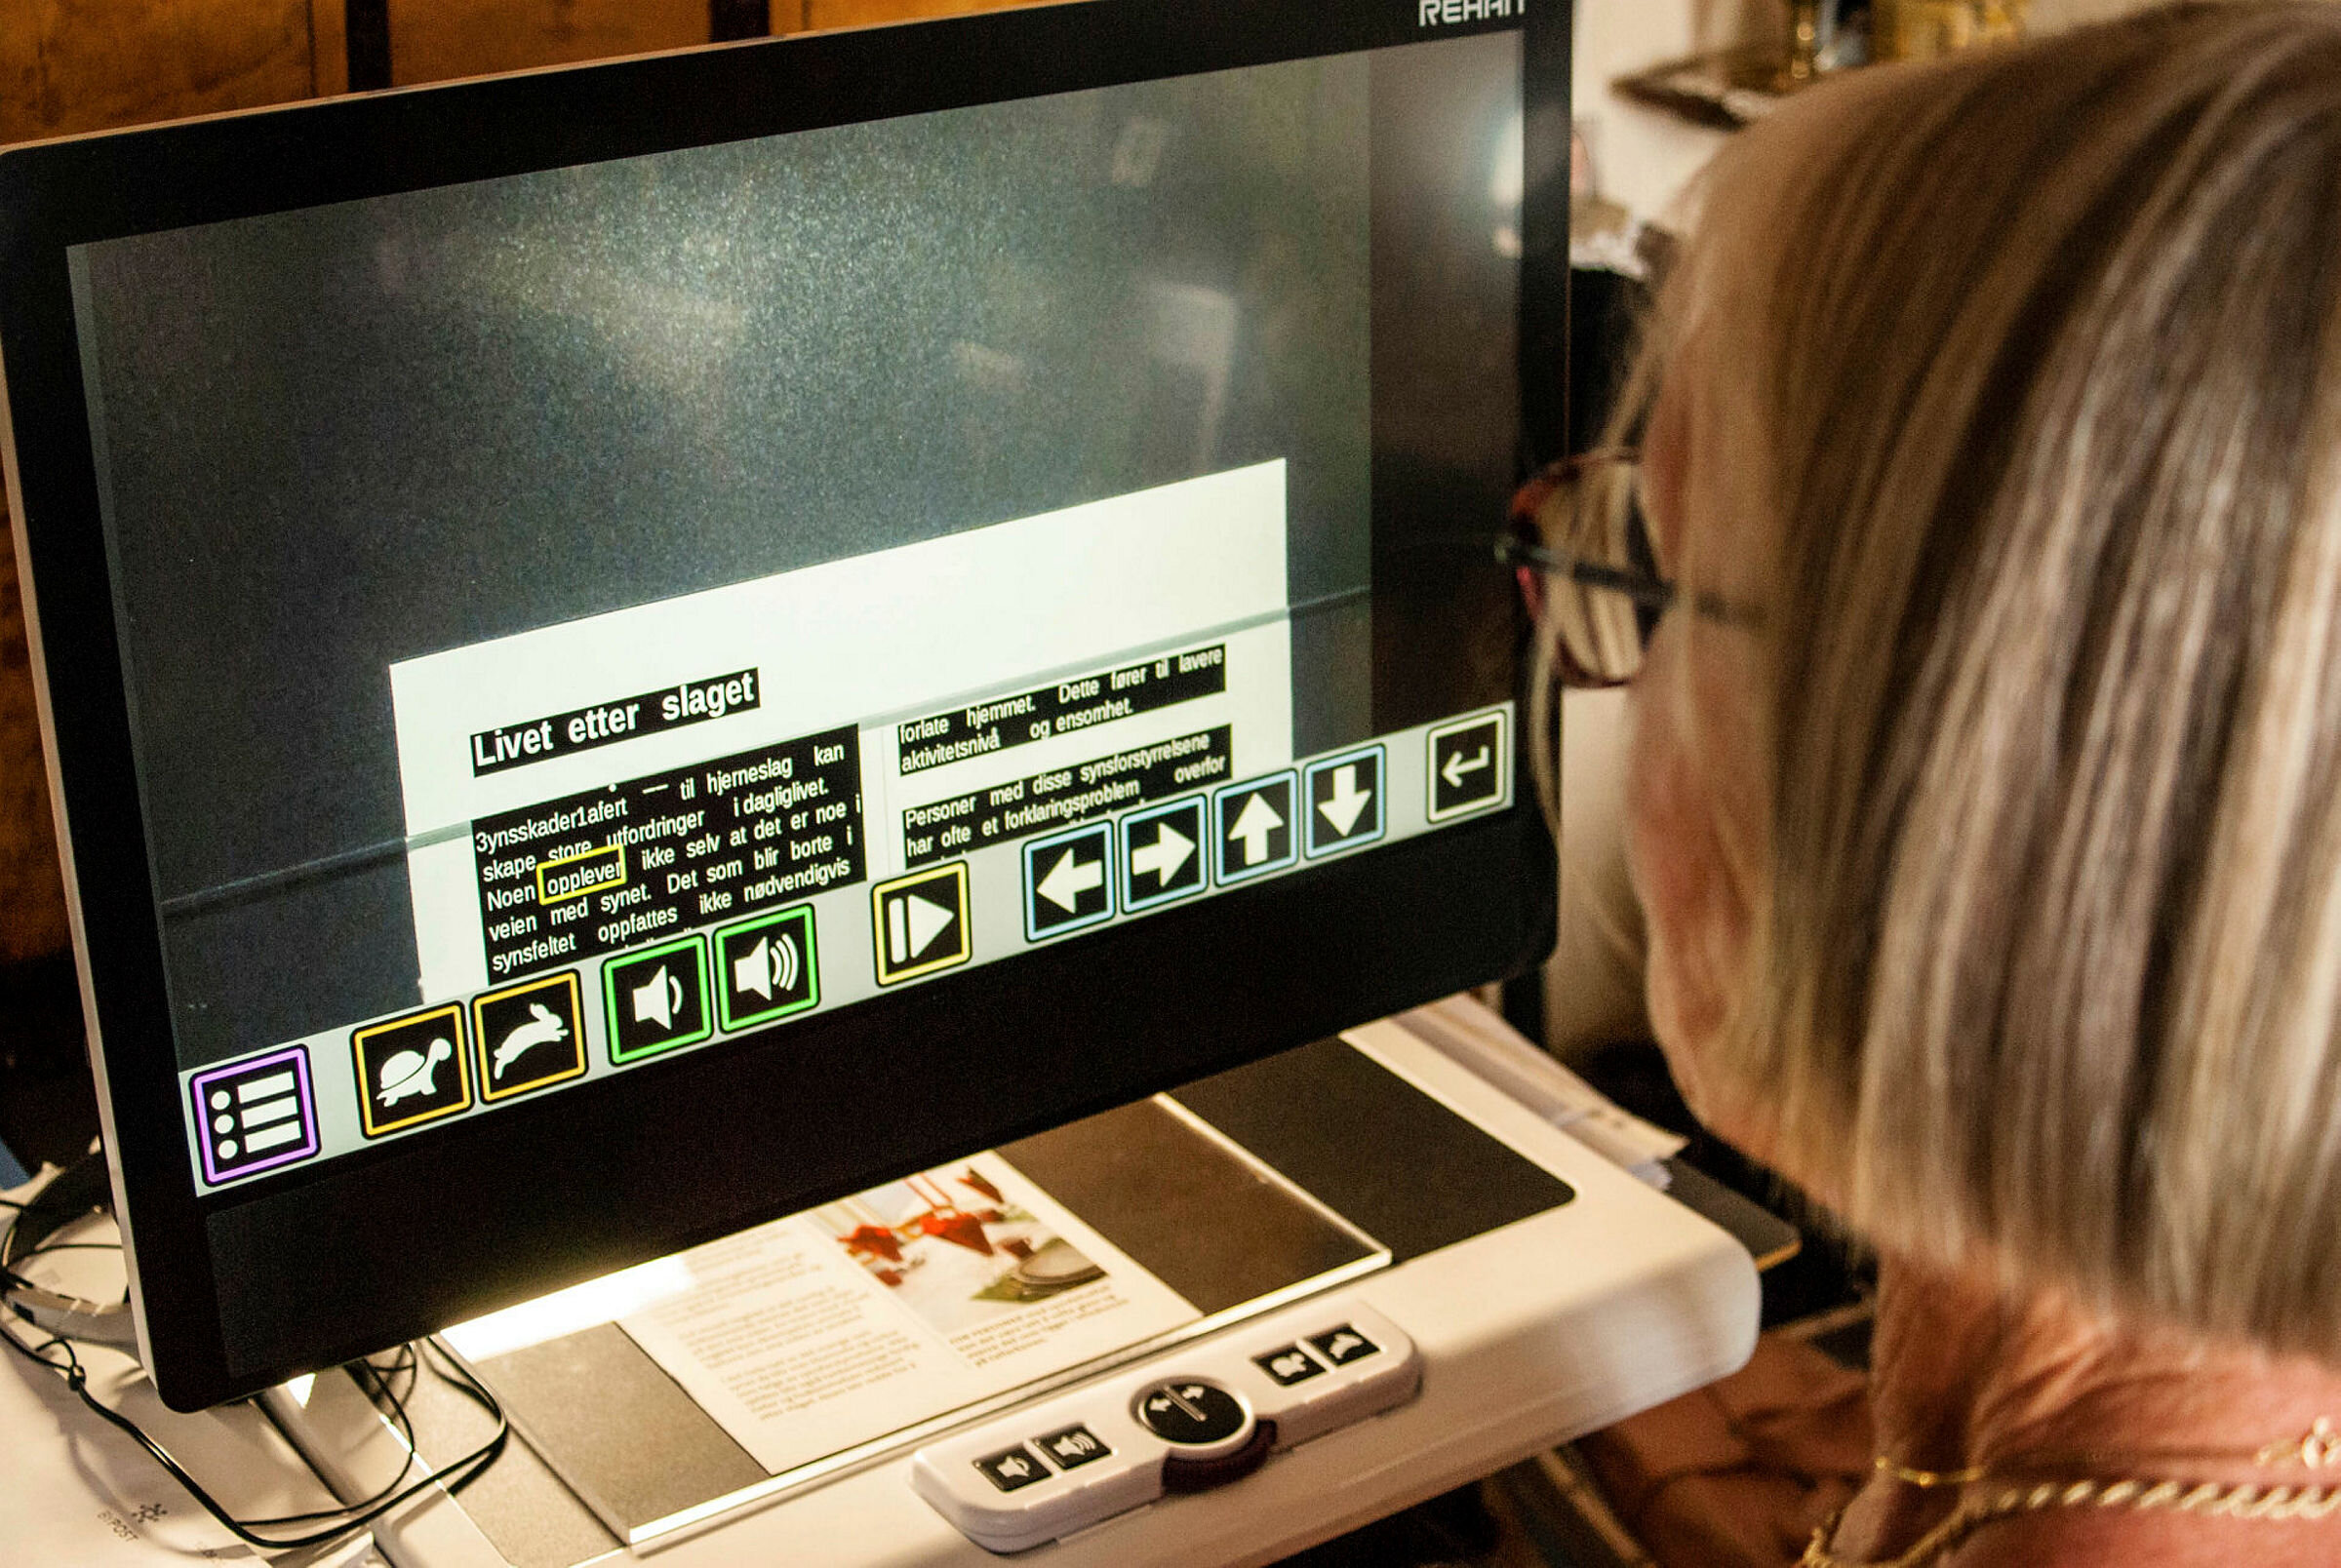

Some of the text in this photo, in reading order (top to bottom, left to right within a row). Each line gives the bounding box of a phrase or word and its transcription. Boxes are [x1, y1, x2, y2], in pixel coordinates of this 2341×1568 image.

[474, 672, 754, 766] Livet etter slaget
[901, 697, 1133, 772] aktivitetsnivå og ensomhet.
[966, 694, 1037, 730] hjemmet.
[1058, 679, 1100, 704] Dette
[1110, 667, 1146, 690] fører
[1178, 648, 1223, 673] lavere
[475, 797, 628, 855] 3ynsskader1afert
[680, 777, 695, 801] til
[705, 757, 793, 797] hjerneslag
[813, 744, 845, 767] kan
[483, 777, 829, 882] skape store utfordringer i dagliglivet.
[905, 733, 1210, 829] Personer med disse synsforstyrrelsene
[906, 755, 1226, 858] har ofte et forklaringsproblem overfor
[487, 884, 536, 912] Noen
[641, 845, 675, 871] ikke
[686, 833, 721, 859] selv
[730, 826, 747, 847] at
[753, 817, 782, 841] det
[790, 811, 809, 830] er
[815, 802, 848, 825] noe
[854, 793, 861, 814] i
[489, 825, 853, 942] veien med synet. Det som blir borte i
[492, 857, 851, 973] synsfeltet oppfattes ikke nødvendigvis
